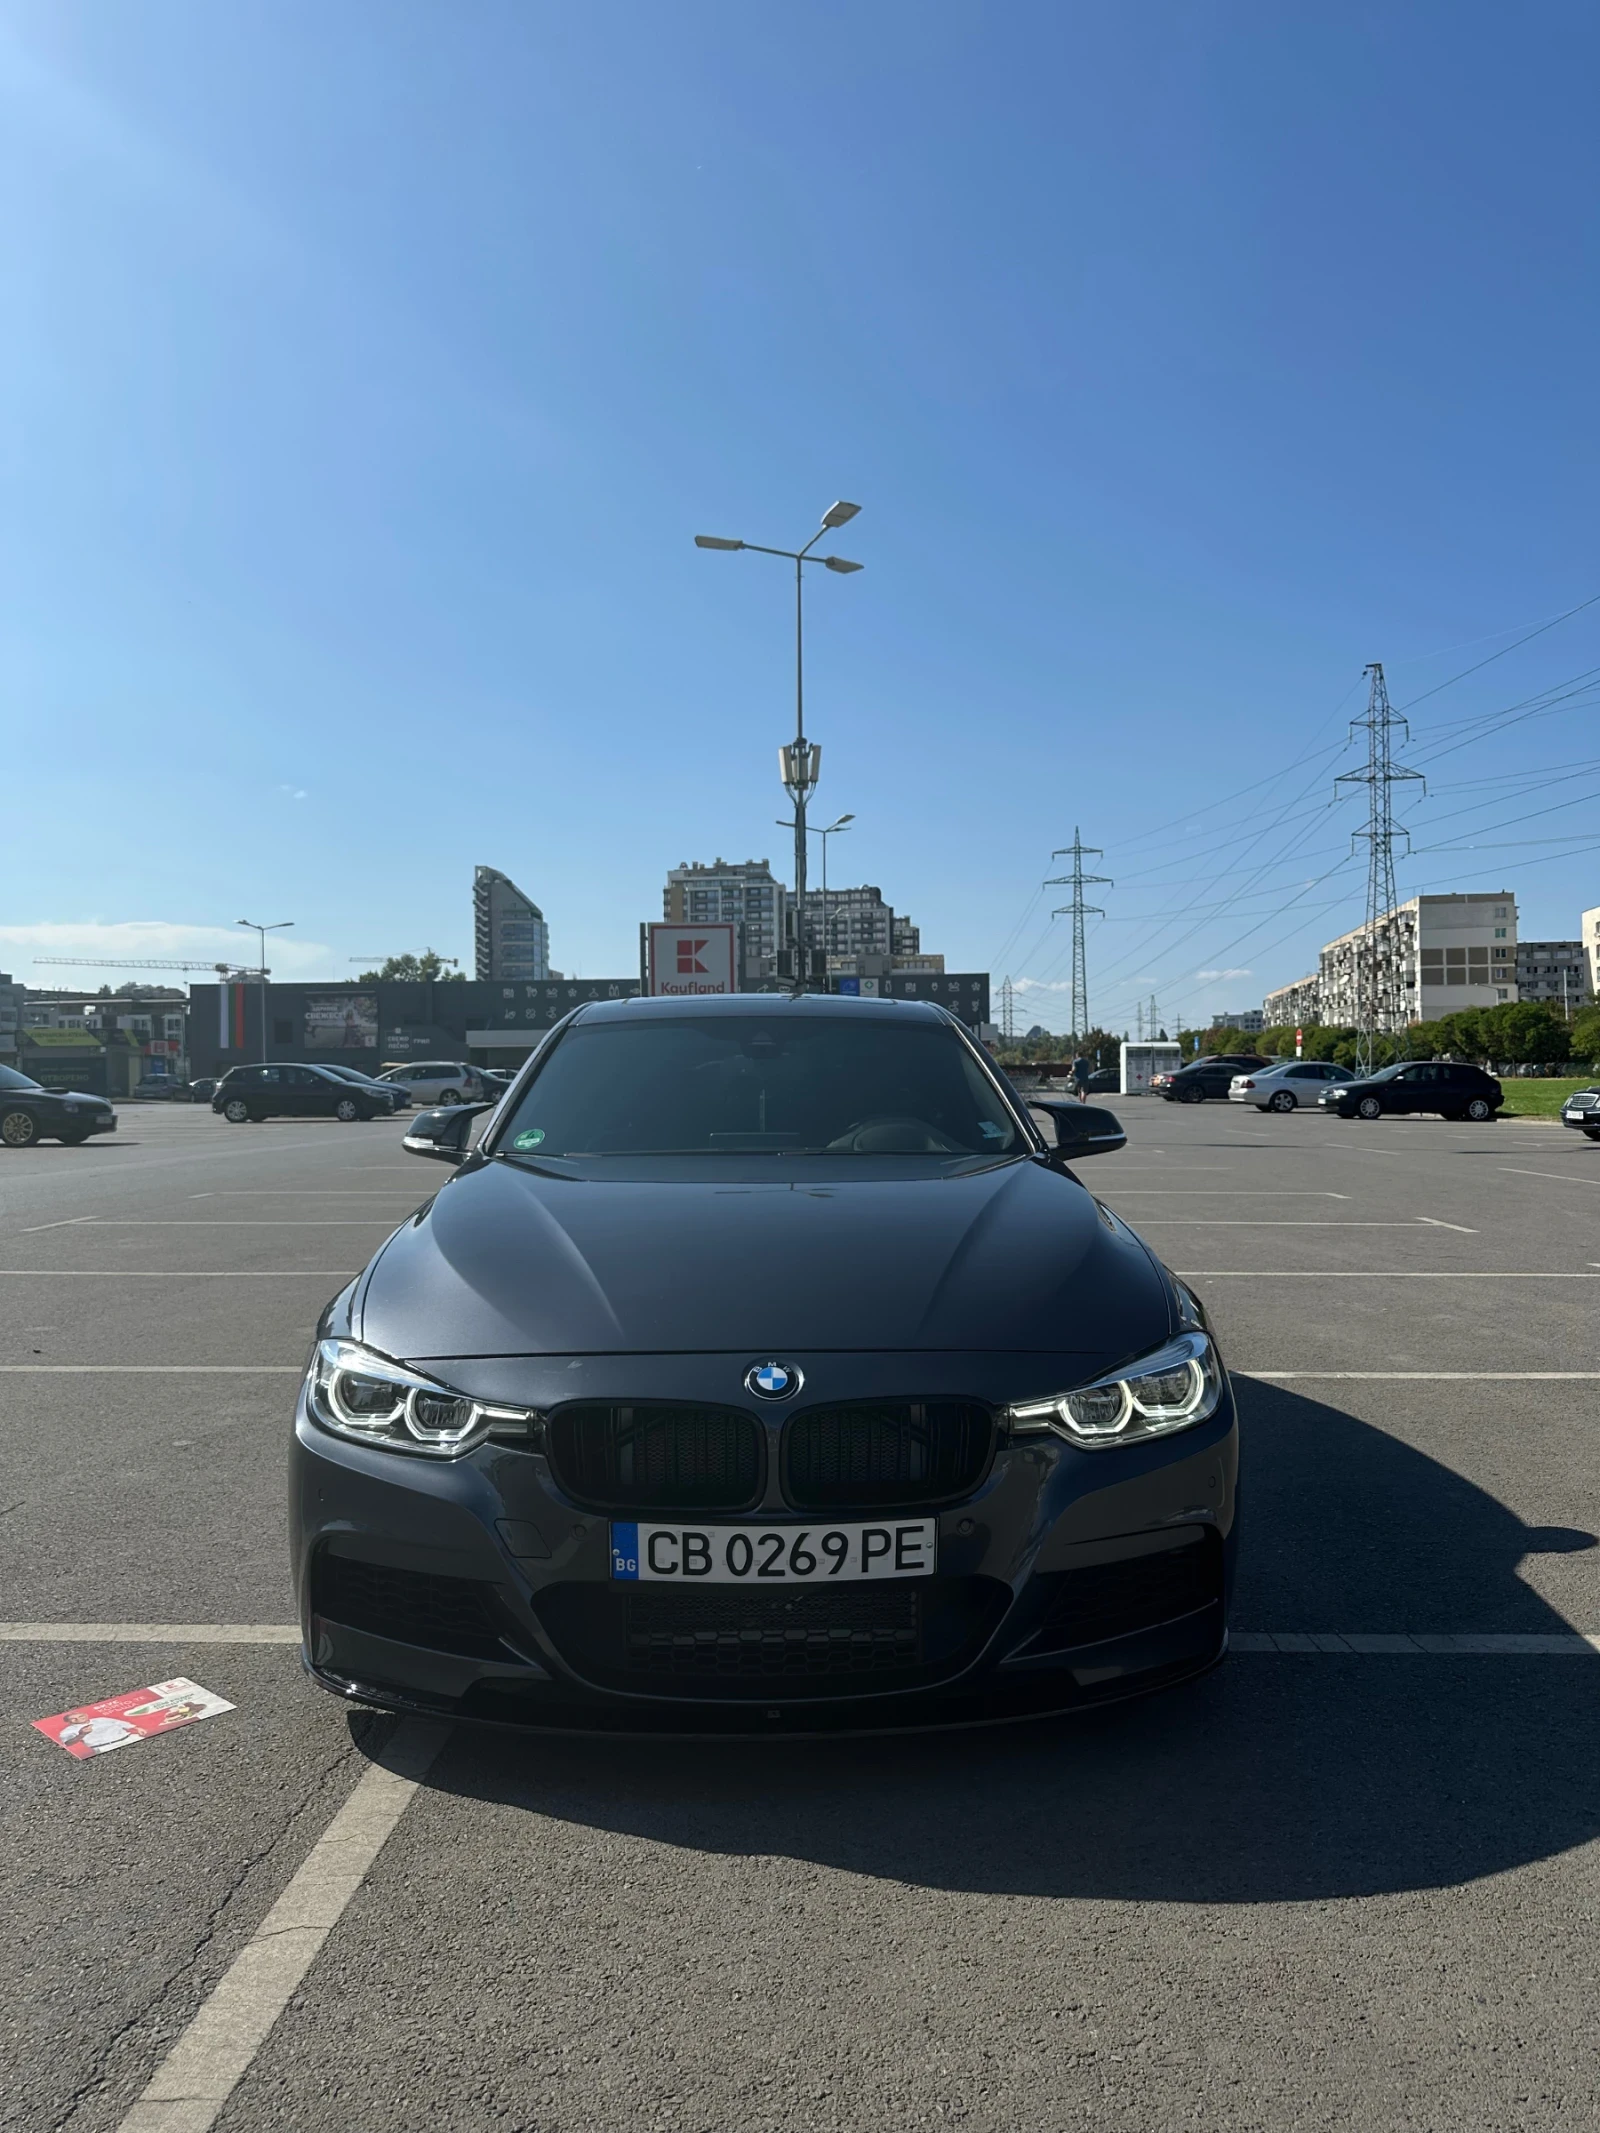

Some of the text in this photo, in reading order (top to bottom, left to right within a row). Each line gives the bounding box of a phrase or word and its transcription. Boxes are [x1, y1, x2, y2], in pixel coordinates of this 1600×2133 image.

[661, 981, 725, 994] Kaufland
[752, 1361, 791, 1373] BMW
[647, 1525, 925, 1577] CB 0269 PE
[615, 1557, 637, 1572] BG
